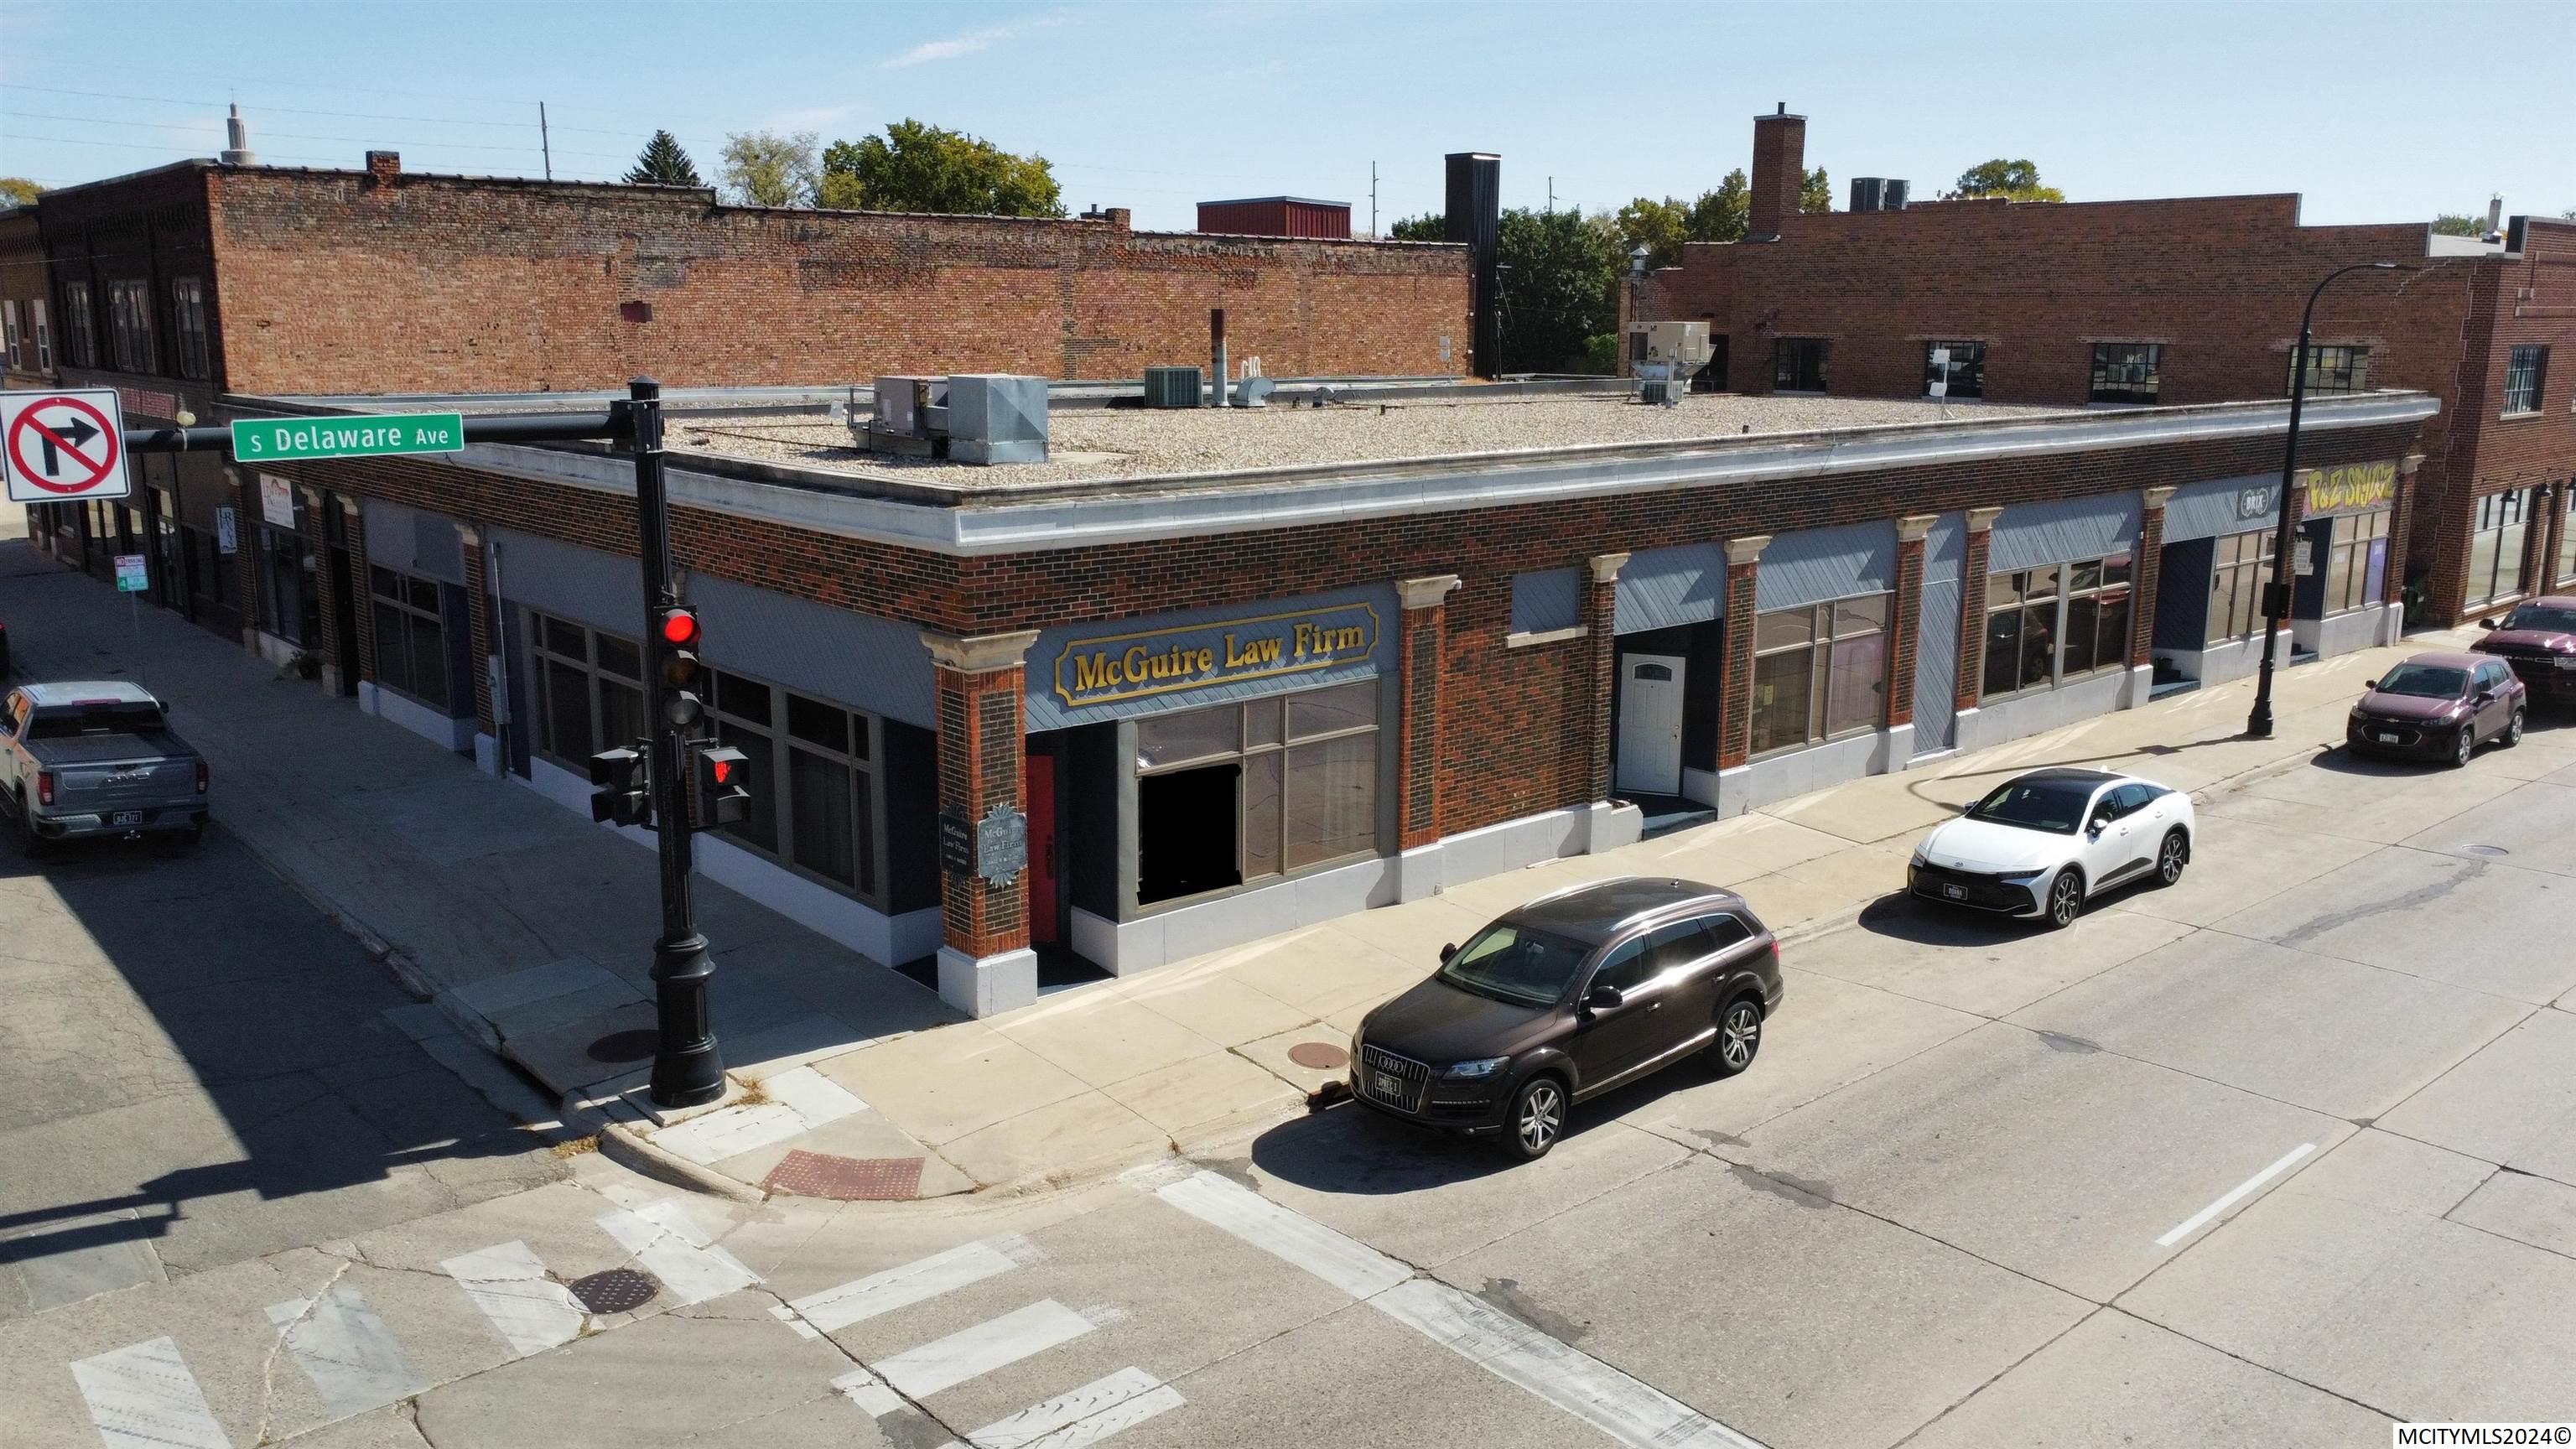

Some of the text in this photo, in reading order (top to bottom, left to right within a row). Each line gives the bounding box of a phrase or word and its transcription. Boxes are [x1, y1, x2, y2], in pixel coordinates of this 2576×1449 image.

[251, 425, 449, 453] S Delaware Ave
[2246, 495, 2263, 511] BRIX
[1074, 622, 1364, 692] McGuire Law Firm
[943, 823, 969, 840] McGuire
[983, 839, 1022, 854] Law Firm
